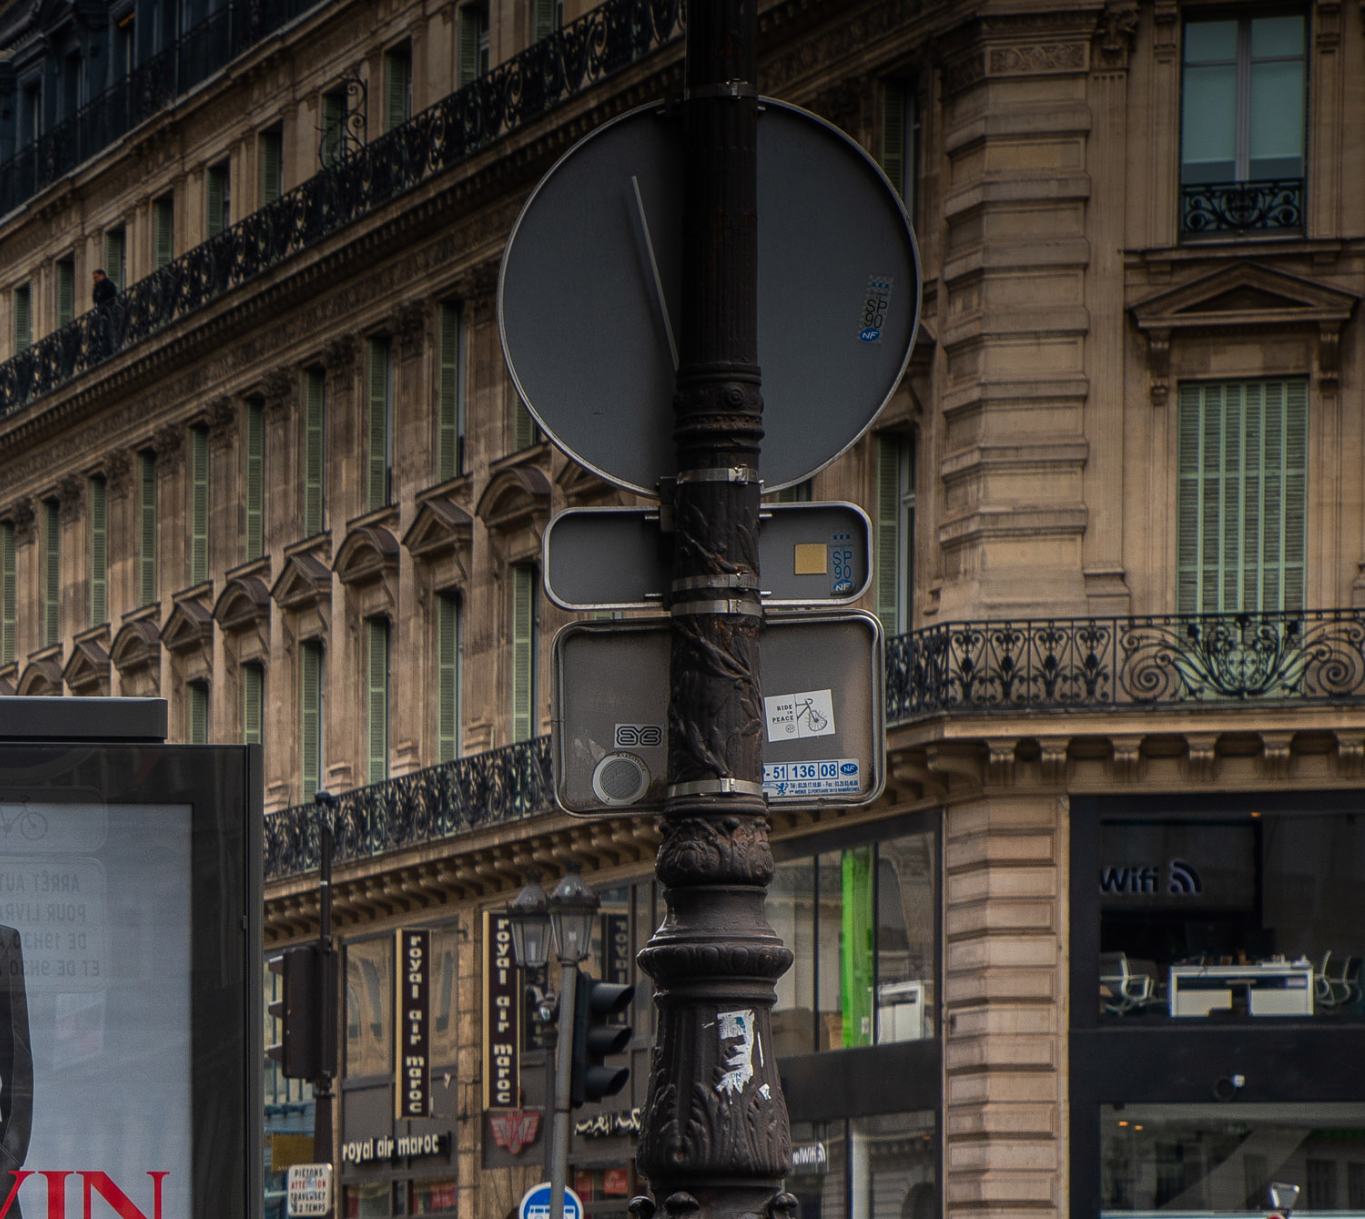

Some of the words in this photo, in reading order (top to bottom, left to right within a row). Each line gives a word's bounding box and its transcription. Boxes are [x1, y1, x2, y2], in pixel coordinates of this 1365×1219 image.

[865, 298, 887, 314] SP
[864, 312, 883, 329] 90
[832, 550, 853, 566] SP
[834, 565, 852, 580] 90
[772, 715, 794, 723] PEACE
[773, 766, 786, 779] 51
[792, 765, 816, 778] 136
[821, 764, 837, 777] 08
[1099, 866, 1159, 893] Wifi
[495, 918, 510, 985] royal
[408, 935, 423, 999] royal
[408, 1009, 423, 1046] air
[495, 996, 510, 1033] air
[405, 1056, 425, 1113] maroc
[493, 1043, 513, 1104] maroc
[342, 1138, 373, 1164] royal
[377, 1135, 394, 1158] air
[397, 1134, 439, 1156] maroc
